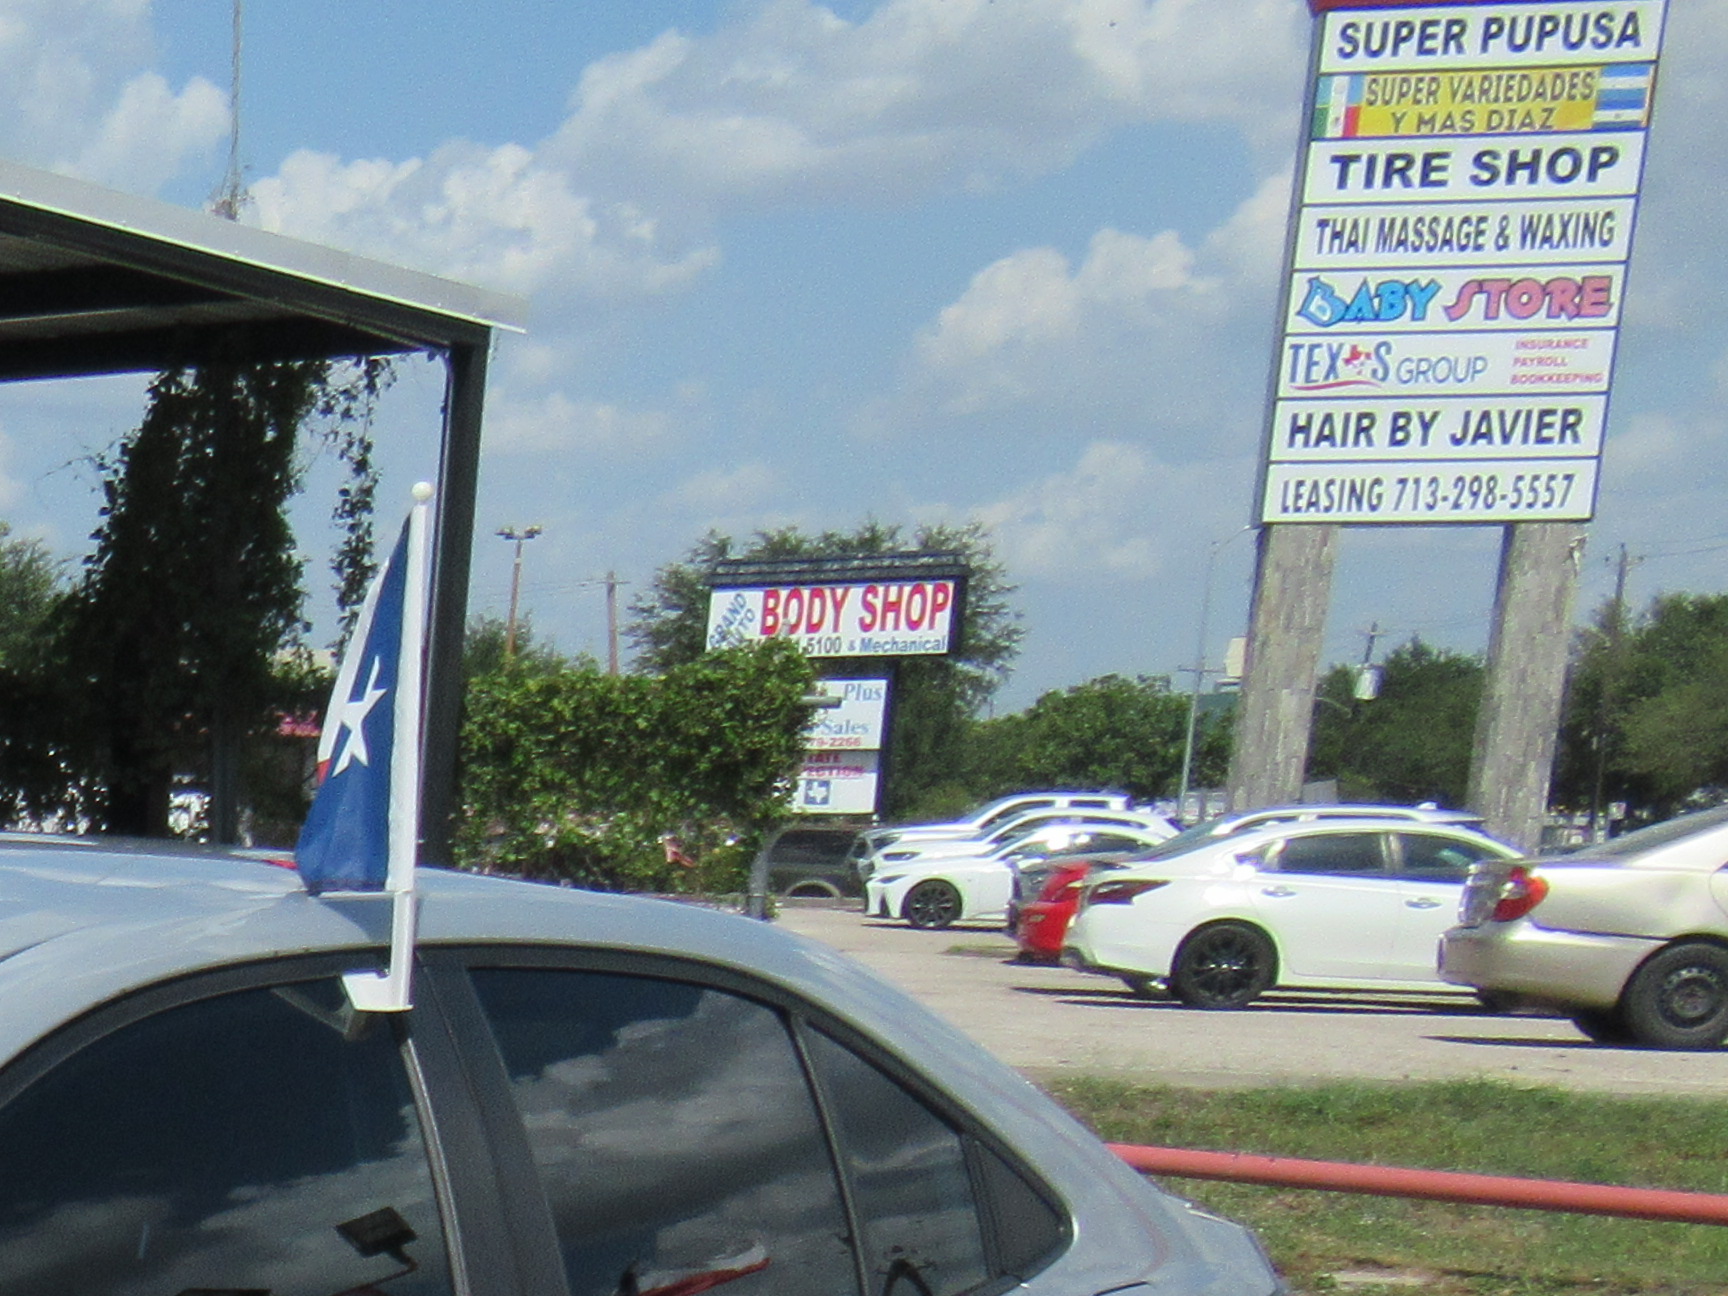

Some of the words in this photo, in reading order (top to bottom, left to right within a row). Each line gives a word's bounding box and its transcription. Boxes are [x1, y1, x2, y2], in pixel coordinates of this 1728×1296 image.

[1337, 18, 1466, 59] SUPER
[1480, 11, 1641, 52] PUPUSA
[1365, 76, 1439, 107] SUPER
[1449, 71, 1595, 103] VARIEDADES
[1391, 112, 1407, 133] Y
[1416, 110, 1475, 133] MAS
[1486, 107, 1556, 132] DIAZ
[1330, 150, 1452, 190] TIRE
[1469, 145, 1620, 186] SHOP
[1315, 218, 1369, 255] THAI
[1374, 215, 1487, 253] MASSAGE
[1494, 215, 1510, 251] &
[1520, 211, 1616, 248] WAXING
[1296, 276, 1442, 327] BABY
[1444, 275, 1614, 322] STORE
[1513, 356, 1568, 368] PAYROLL
[1515, 338, 1589, 350] INSURANCE
[1397, 356, 1488, 383] GROUP
[1510, 371, 1603, 385] BOOKKEEPING
[1287, 411, 1376, 450] HAIR
[1388, 410, 1440, 447] BY
[1449, 408, 1584, 447] JAVIER
[1280, 479, 1383, 514] LEASING
[1394, 473, 1576, 511] 713-298-5557
[760, 586, 851, 635] BODY
[859, 582, 951, 632] SHOP
[859, 635, 947, 654] Mechanical
[845, 683, 881, 700] Plus
